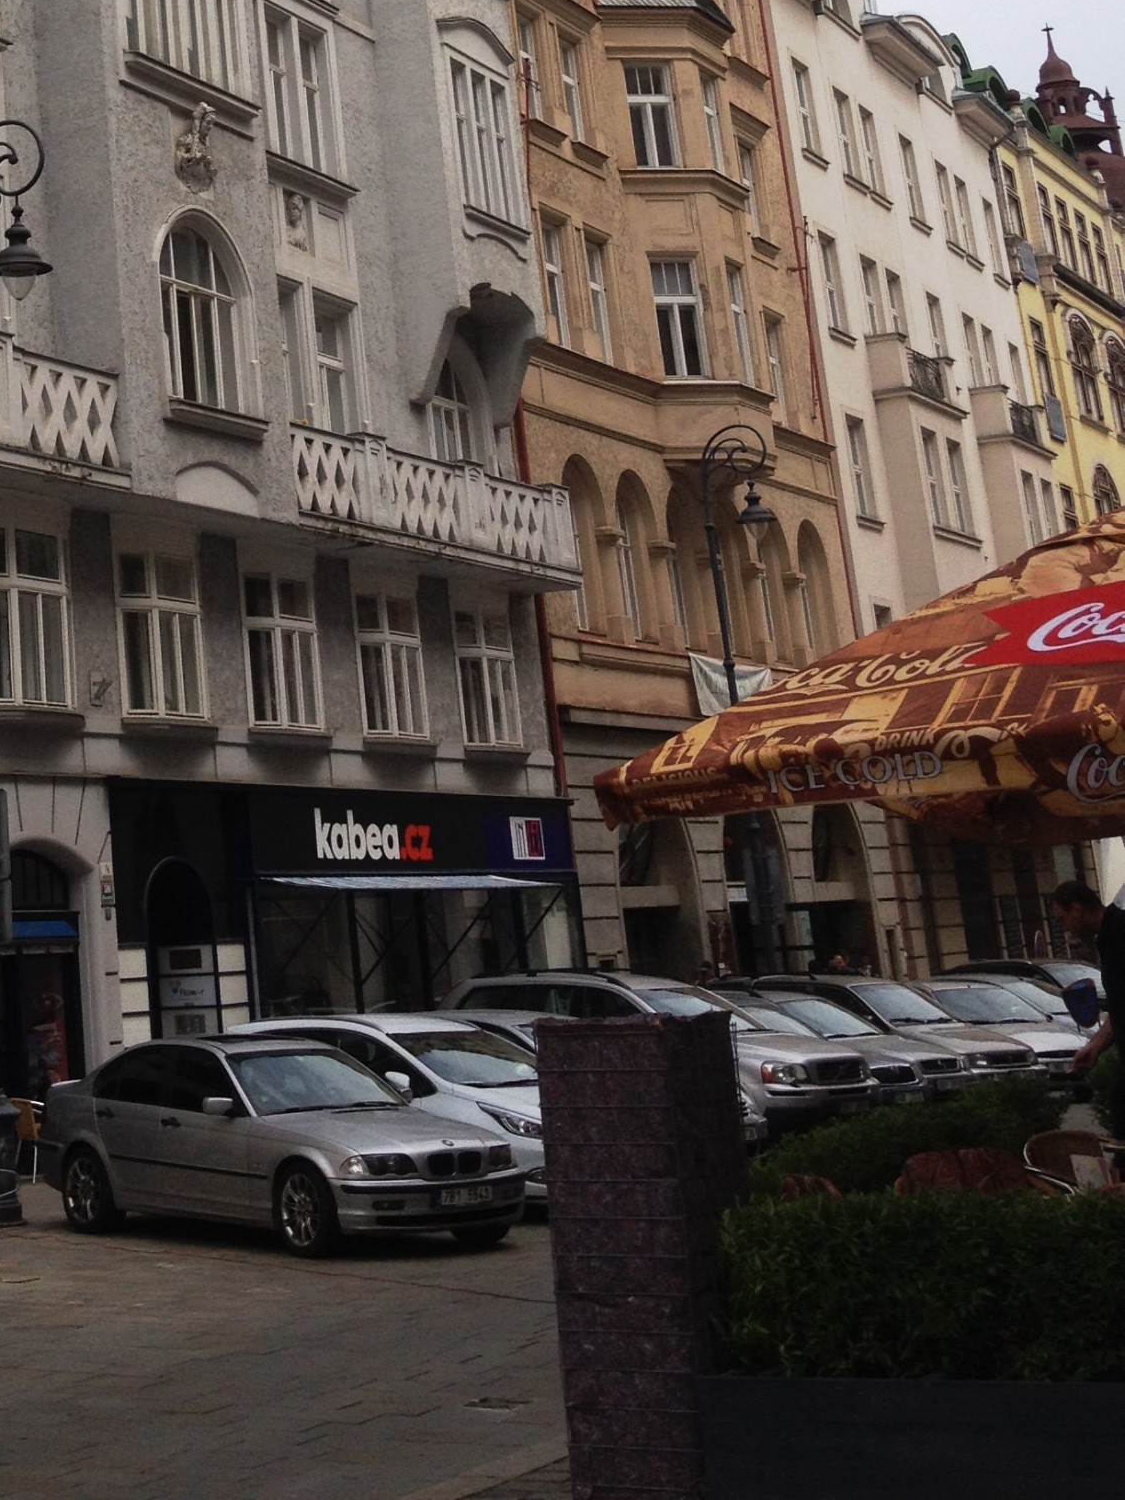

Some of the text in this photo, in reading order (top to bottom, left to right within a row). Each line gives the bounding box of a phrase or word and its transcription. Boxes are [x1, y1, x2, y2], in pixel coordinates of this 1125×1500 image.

[1027, 602, 1125, 652] Coc
[876, 729, 936, 750] DRINK
[767, 751, 943, 794] ICE COLD
[1067, 743, 1125, 804] Coc
[313, 807, 434, 862] kabea.cz
